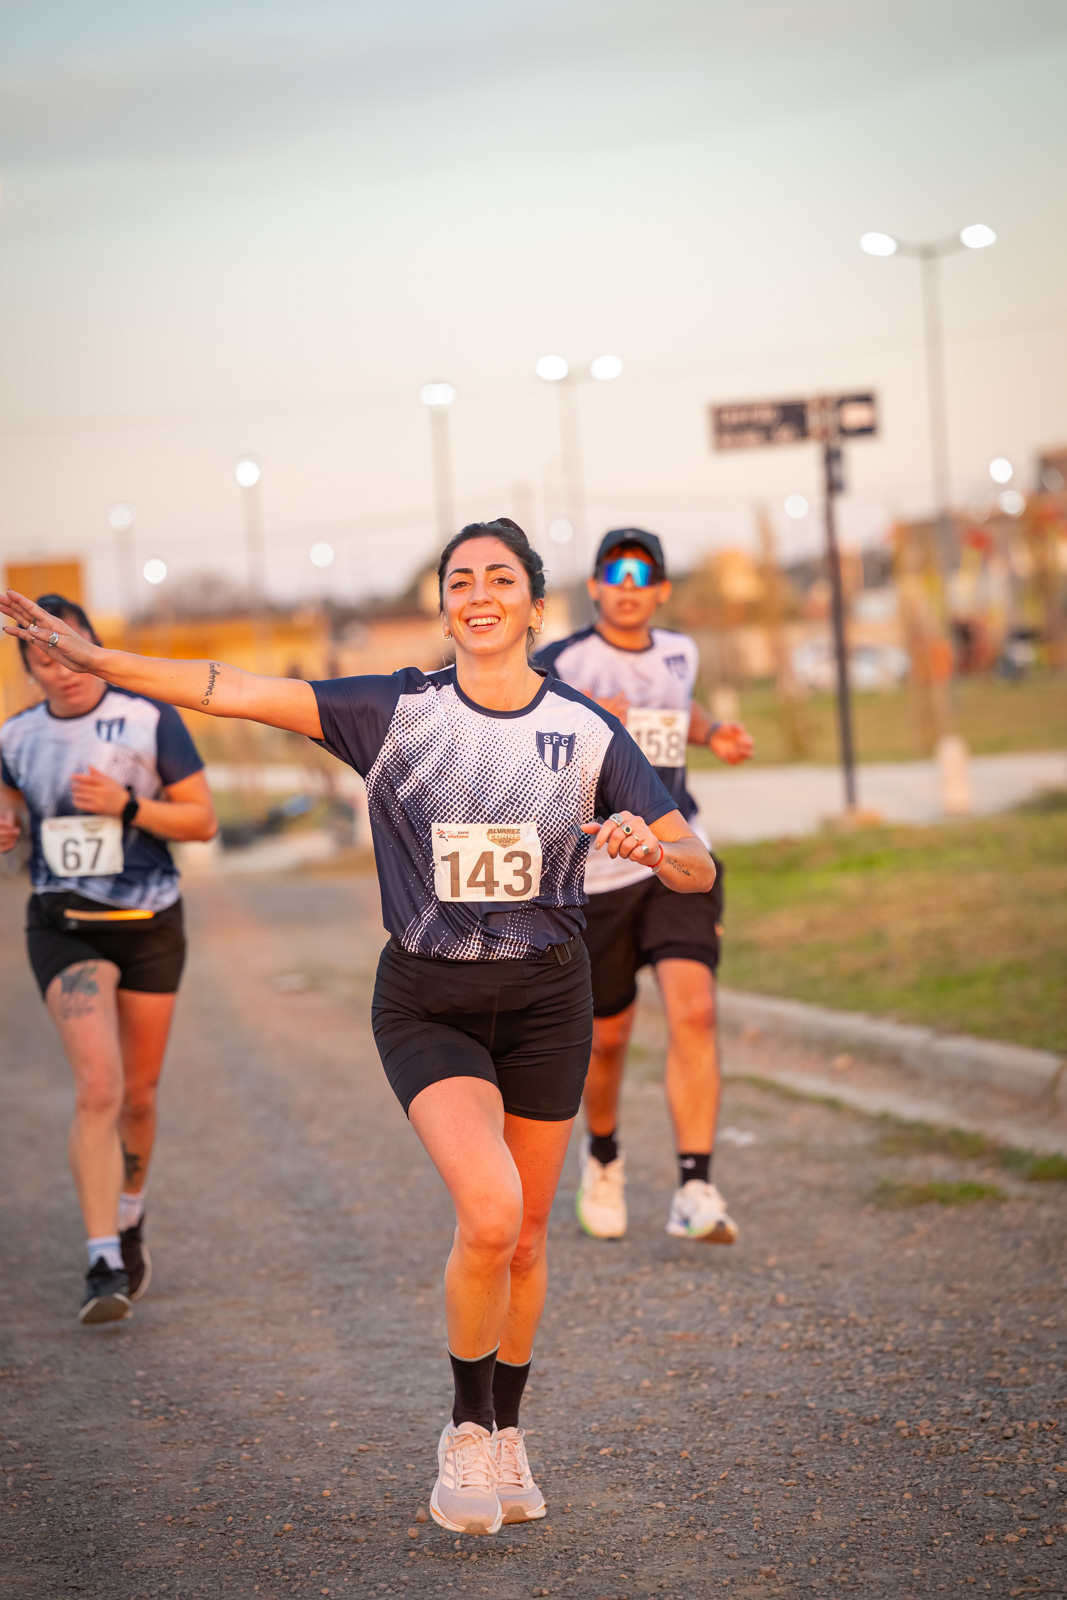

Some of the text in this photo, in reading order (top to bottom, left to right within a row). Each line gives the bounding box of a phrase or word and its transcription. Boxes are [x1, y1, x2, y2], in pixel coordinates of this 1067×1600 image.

[543, 734, 569, 747] SFC
[61, 837, 104, 872] 67
[440, 850, 533, 898] 143
